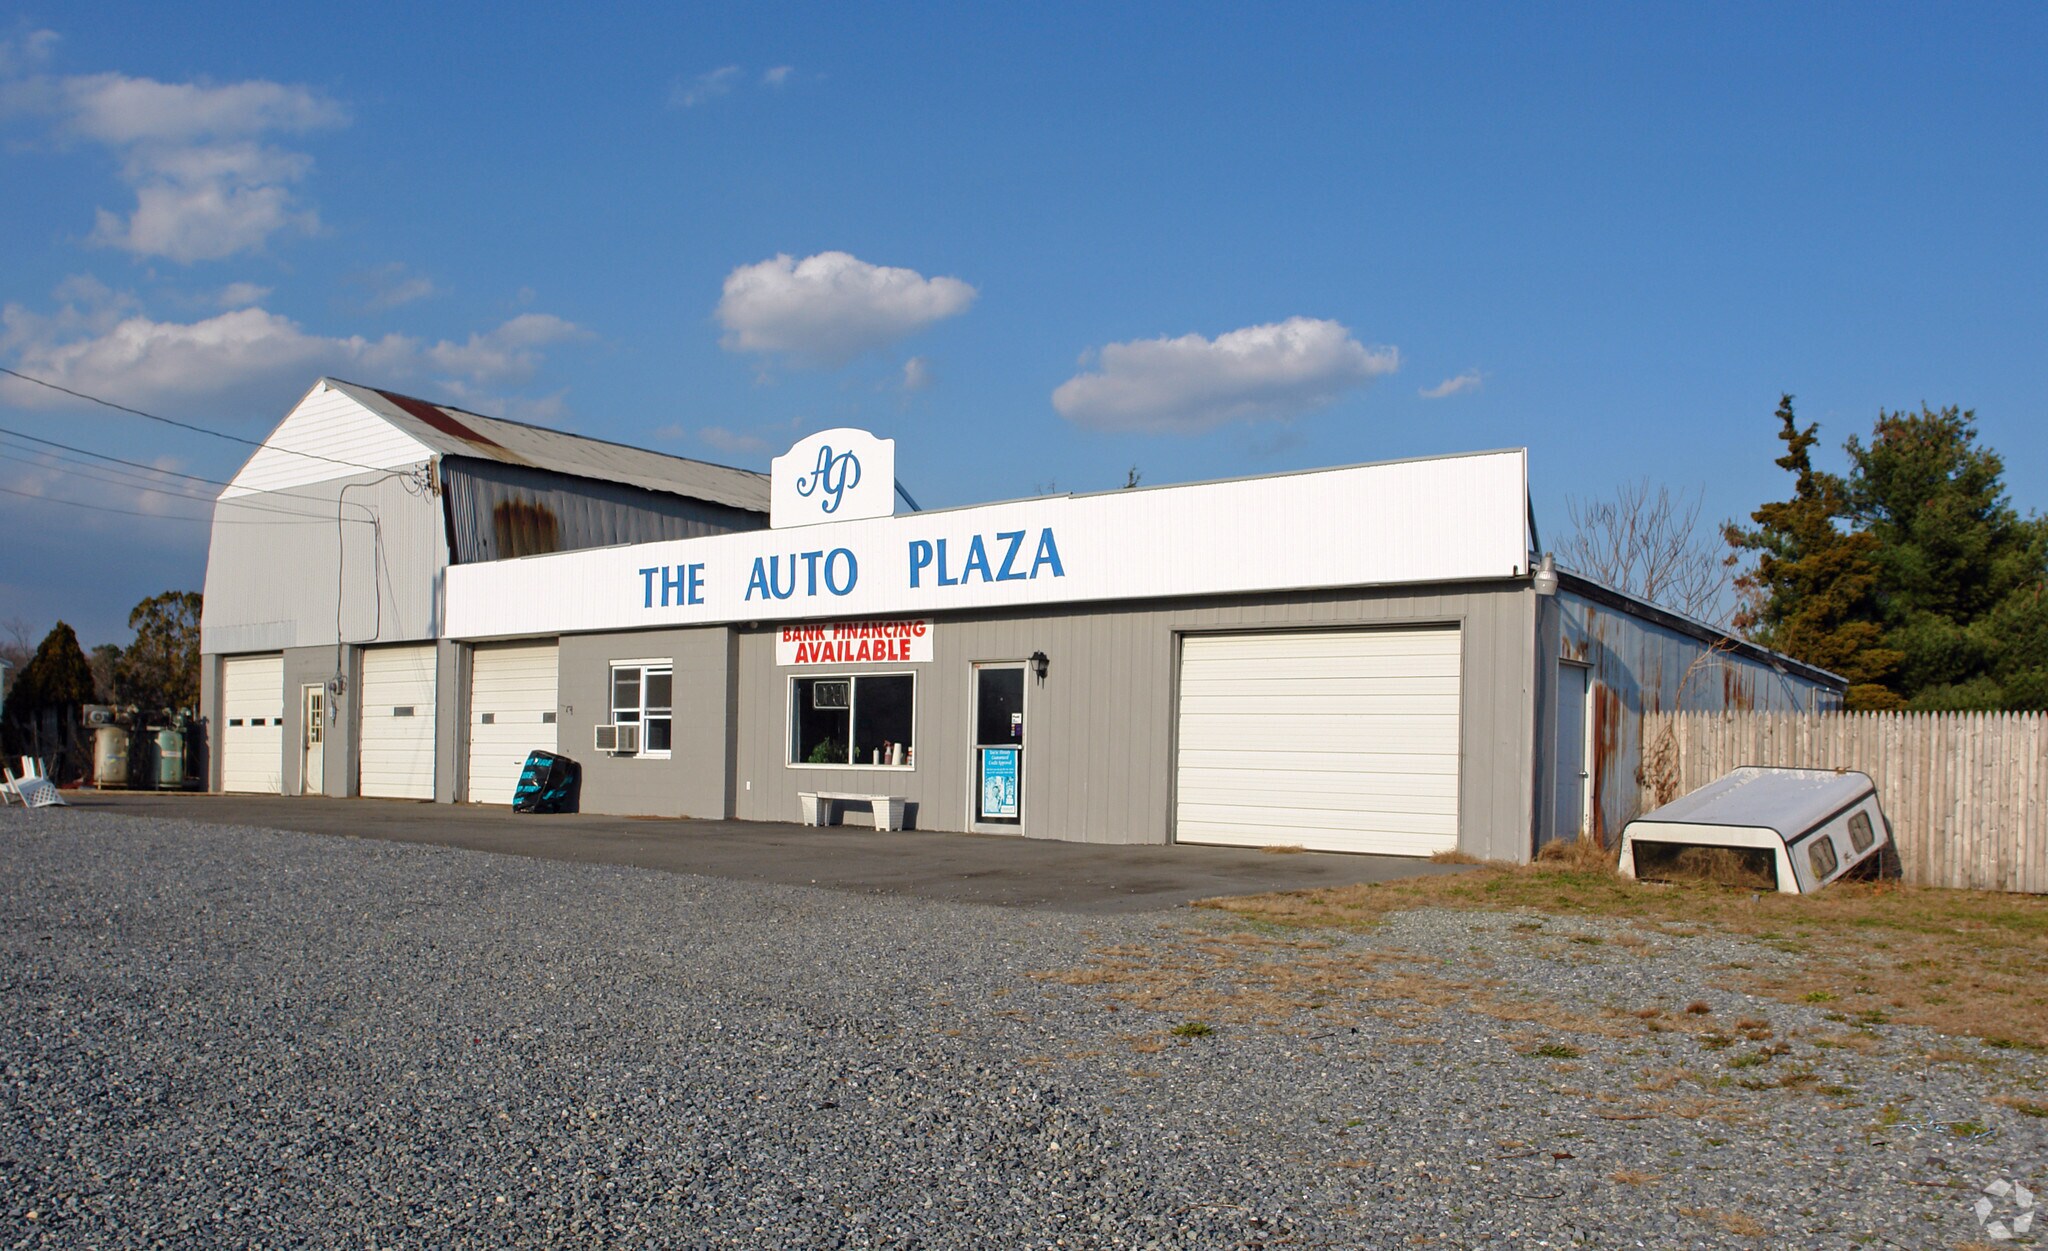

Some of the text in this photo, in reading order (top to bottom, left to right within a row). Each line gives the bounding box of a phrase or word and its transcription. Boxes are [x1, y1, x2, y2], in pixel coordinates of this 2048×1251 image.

[639, 527, 1065, 608] THE AUTO PLAZA
[783, 620, 926, 642] BANK FINANCING
[795, 639, 911, 663] AVAILABLE
[816, 684, 849, 706] OPEN
